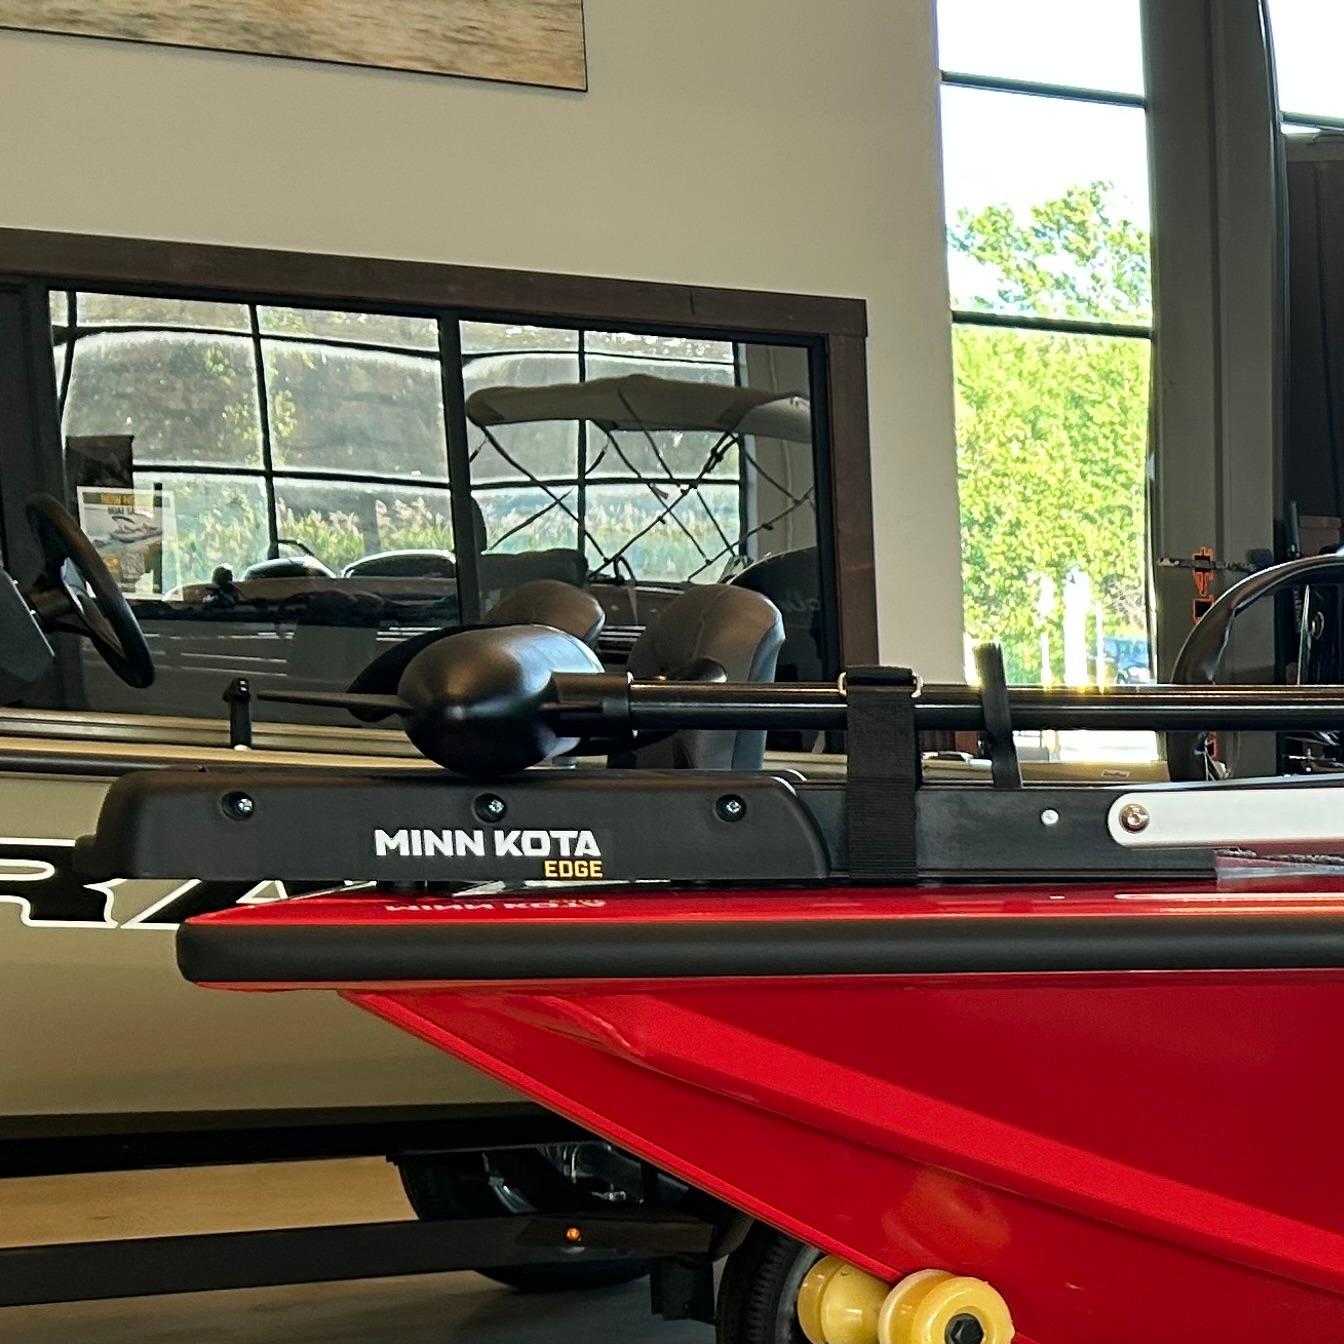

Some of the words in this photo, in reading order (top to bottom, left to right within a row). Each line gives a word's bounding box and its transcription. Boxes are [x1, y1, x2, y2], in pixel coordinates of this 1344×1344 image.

[374, 829, 485, 857] MINN
[494, 830, 601, 857] KOTA
[543, 860, 603, 878] EDGE
